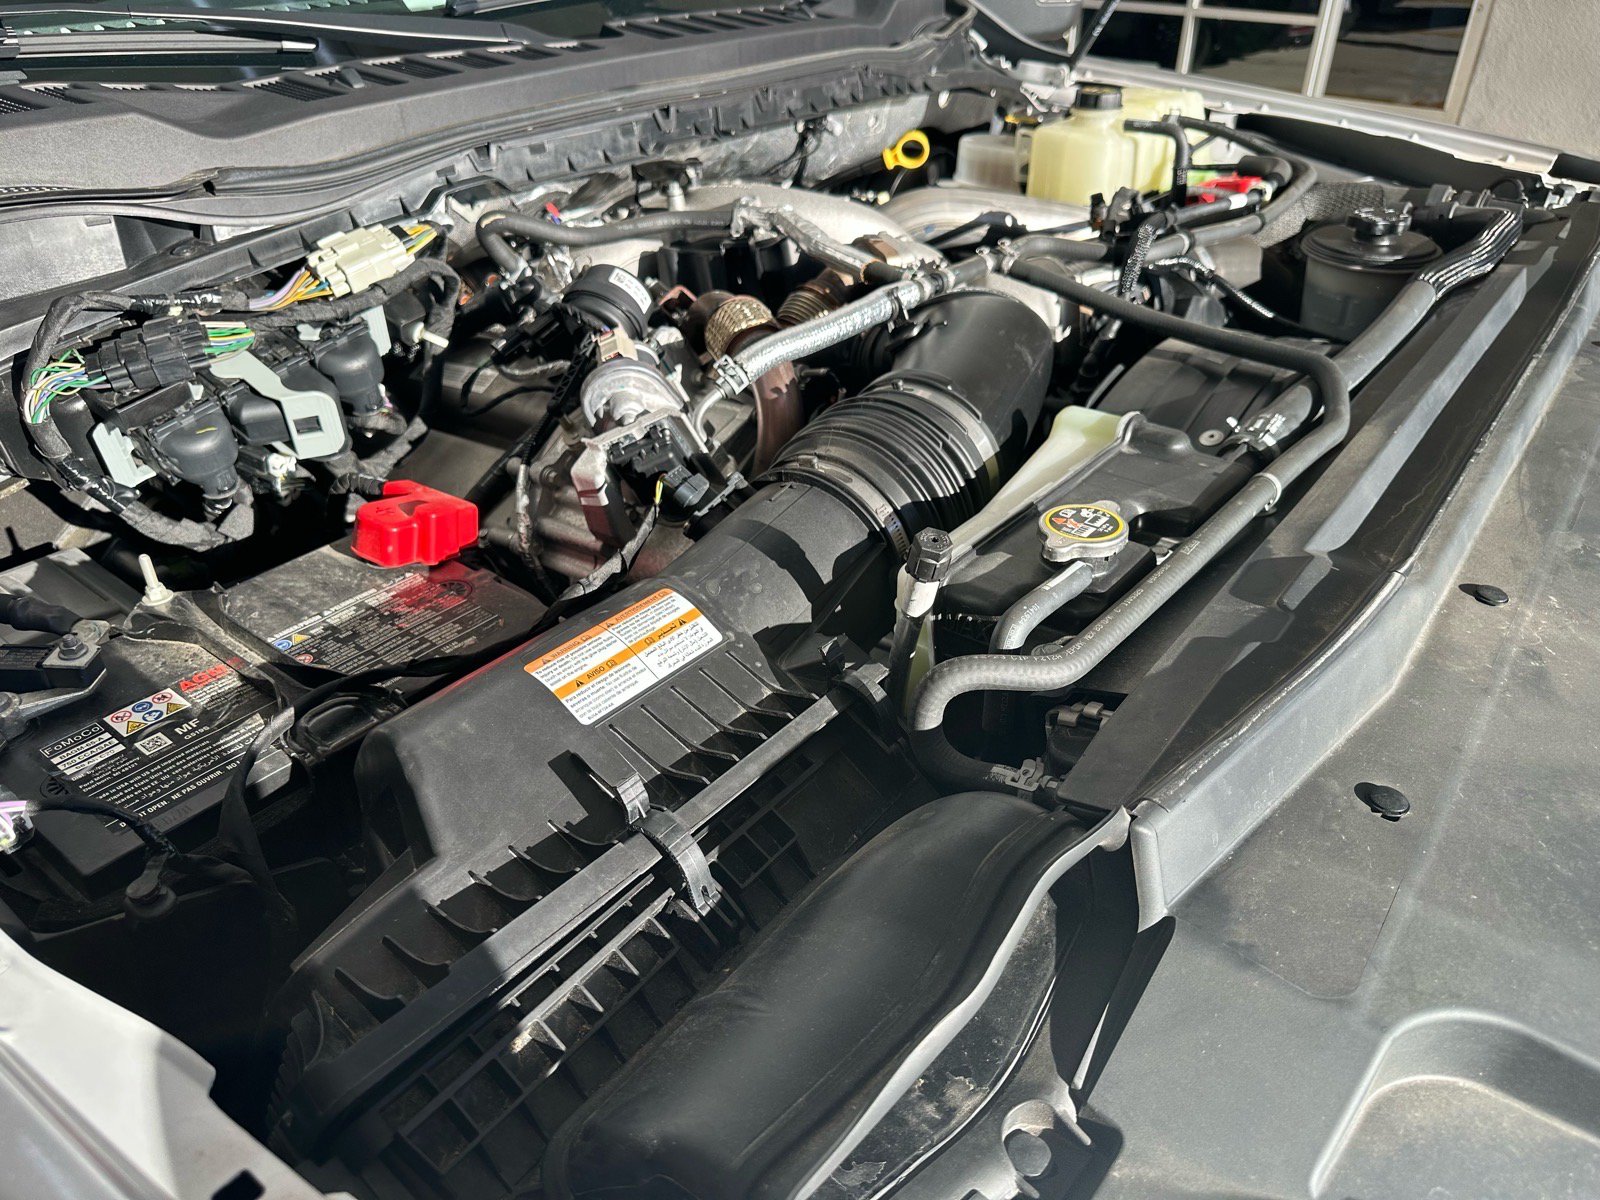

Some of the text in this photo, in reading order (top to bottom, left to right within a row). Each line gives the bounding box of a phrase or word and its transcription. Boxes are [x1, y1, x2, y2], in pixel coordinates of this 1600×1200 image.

[551, 641, 581, 659] WARNING
[541, 662, 556, 672] reduce
[585, 666, 606, 679] AVISO
[178, 664, 227, 692] AGM
[564, 695, 576, 703] Para
[174, 718, 200, 736] MF
[44, 724, 100, 757] FoMoCo
[62, 738, 115, 768] 750 CCA/SAE
[78, 779, 94, 788] Ford
[94, 770, 111, 781] Motor
[170, 790, 182, 800] NE
[180, 783, 197, 795] PAS
